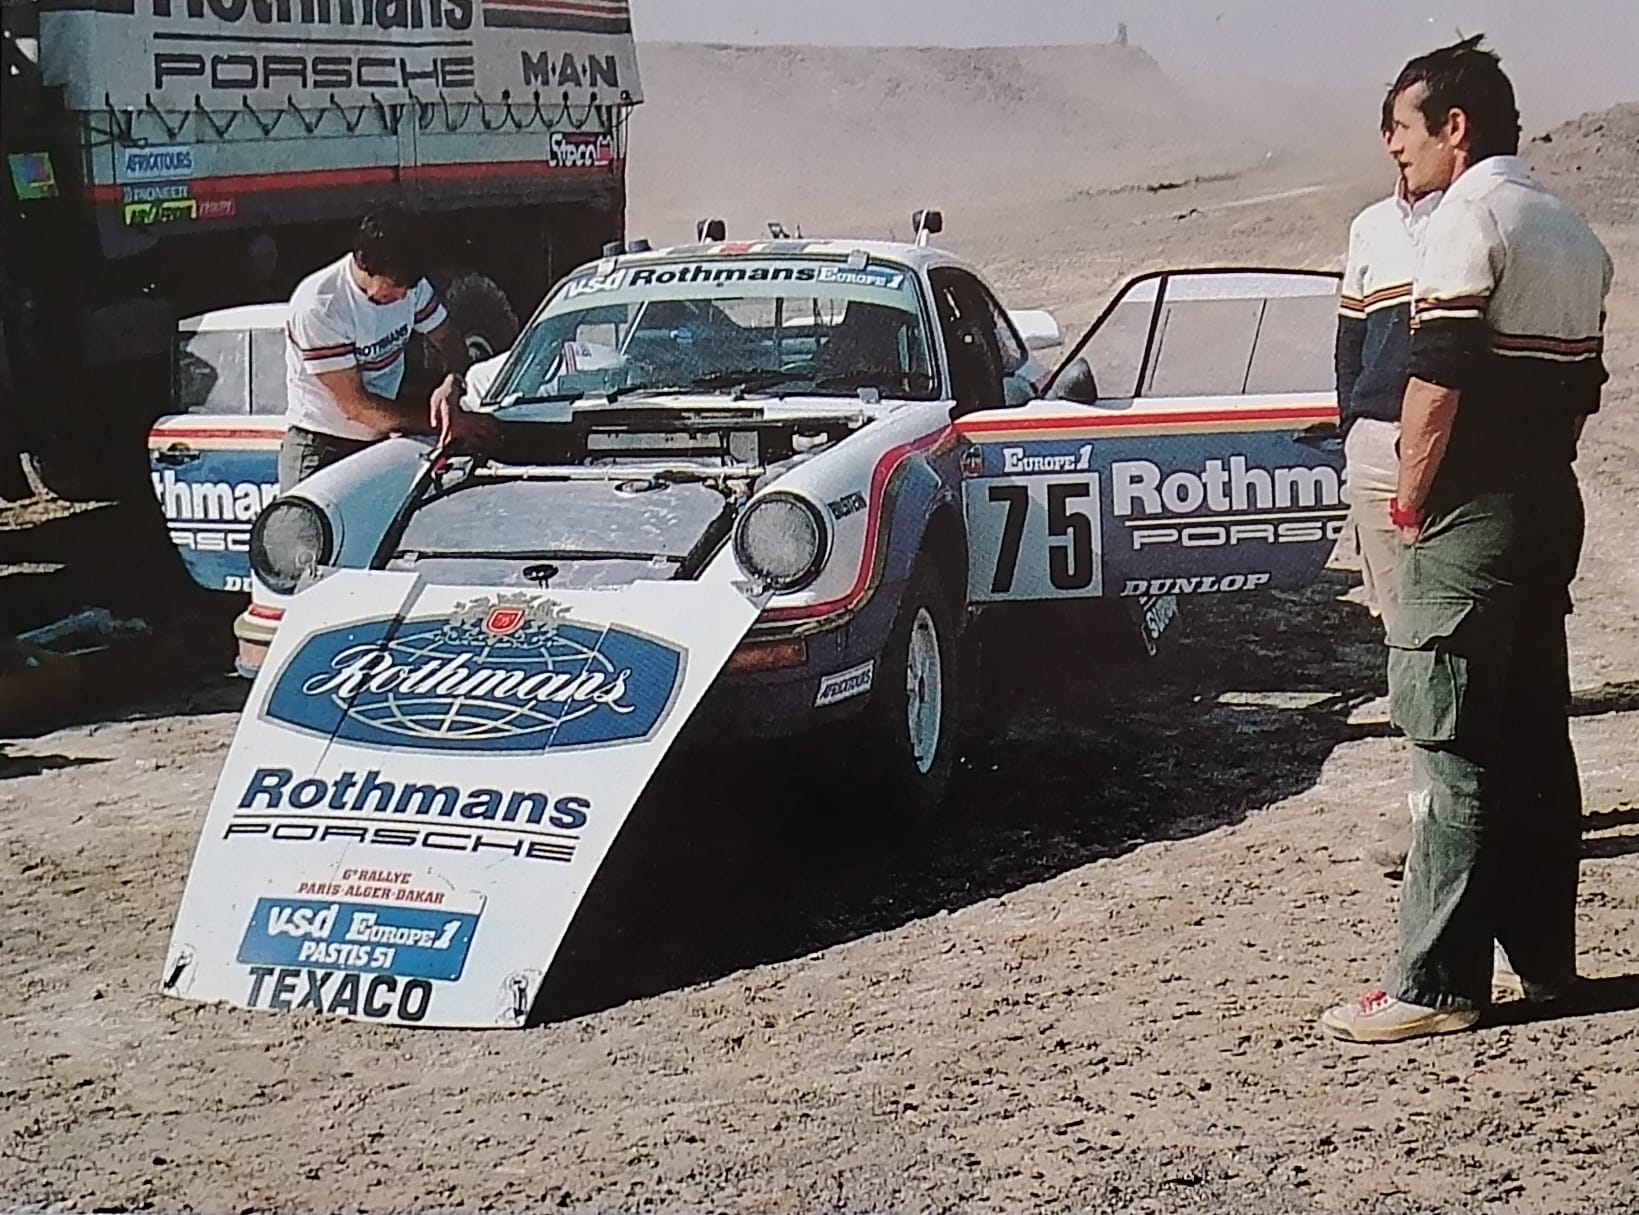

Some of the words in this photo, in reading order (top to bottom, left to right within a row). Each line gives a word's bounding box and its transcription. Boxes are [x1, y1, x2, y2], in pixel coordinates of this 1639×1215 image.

[154, 53, 475, 89] PORSCHE
[628, 265, 817, 287] Rothmans
[1111, 455, 1351, 516] Rothm
[987, 482, 1094, 594] 75
[1120, 573, 1270, 597] DUNLOP
[302, 645, 634, 713] Rothmans
[237, 768, 592, 830] Rothmans
[222, 823, 577, 863] PORSCHE
[358, 870, 413, 885] RALLYE
[299, 940, 371, 968] PASTIS
[371, 945, 396, 969] 51
[247, 966, 433, 1023] TEXACO
